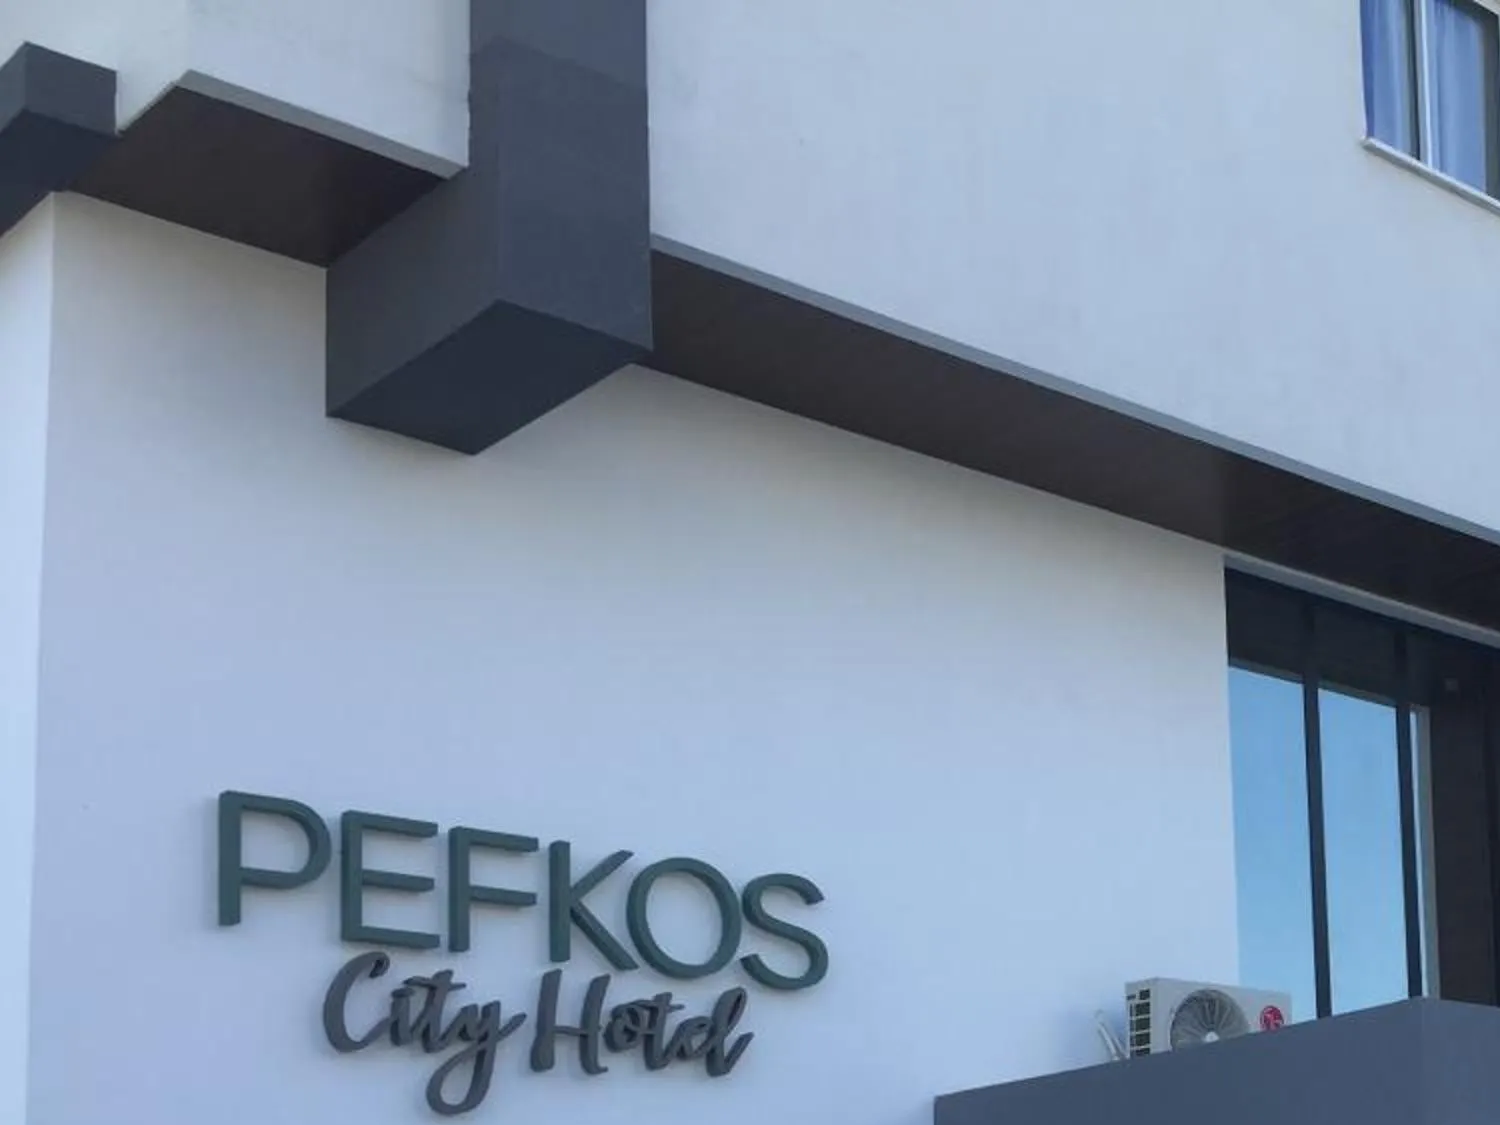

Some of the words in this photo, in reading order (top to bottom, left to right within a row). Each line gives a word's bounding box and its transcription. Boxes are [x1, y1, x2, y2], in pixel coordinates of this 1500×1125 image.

[218, 790, 829, 991] PEFKOS
[322, 951, 527, 1116] City
[530, 968, 754, 1077] Hotel
